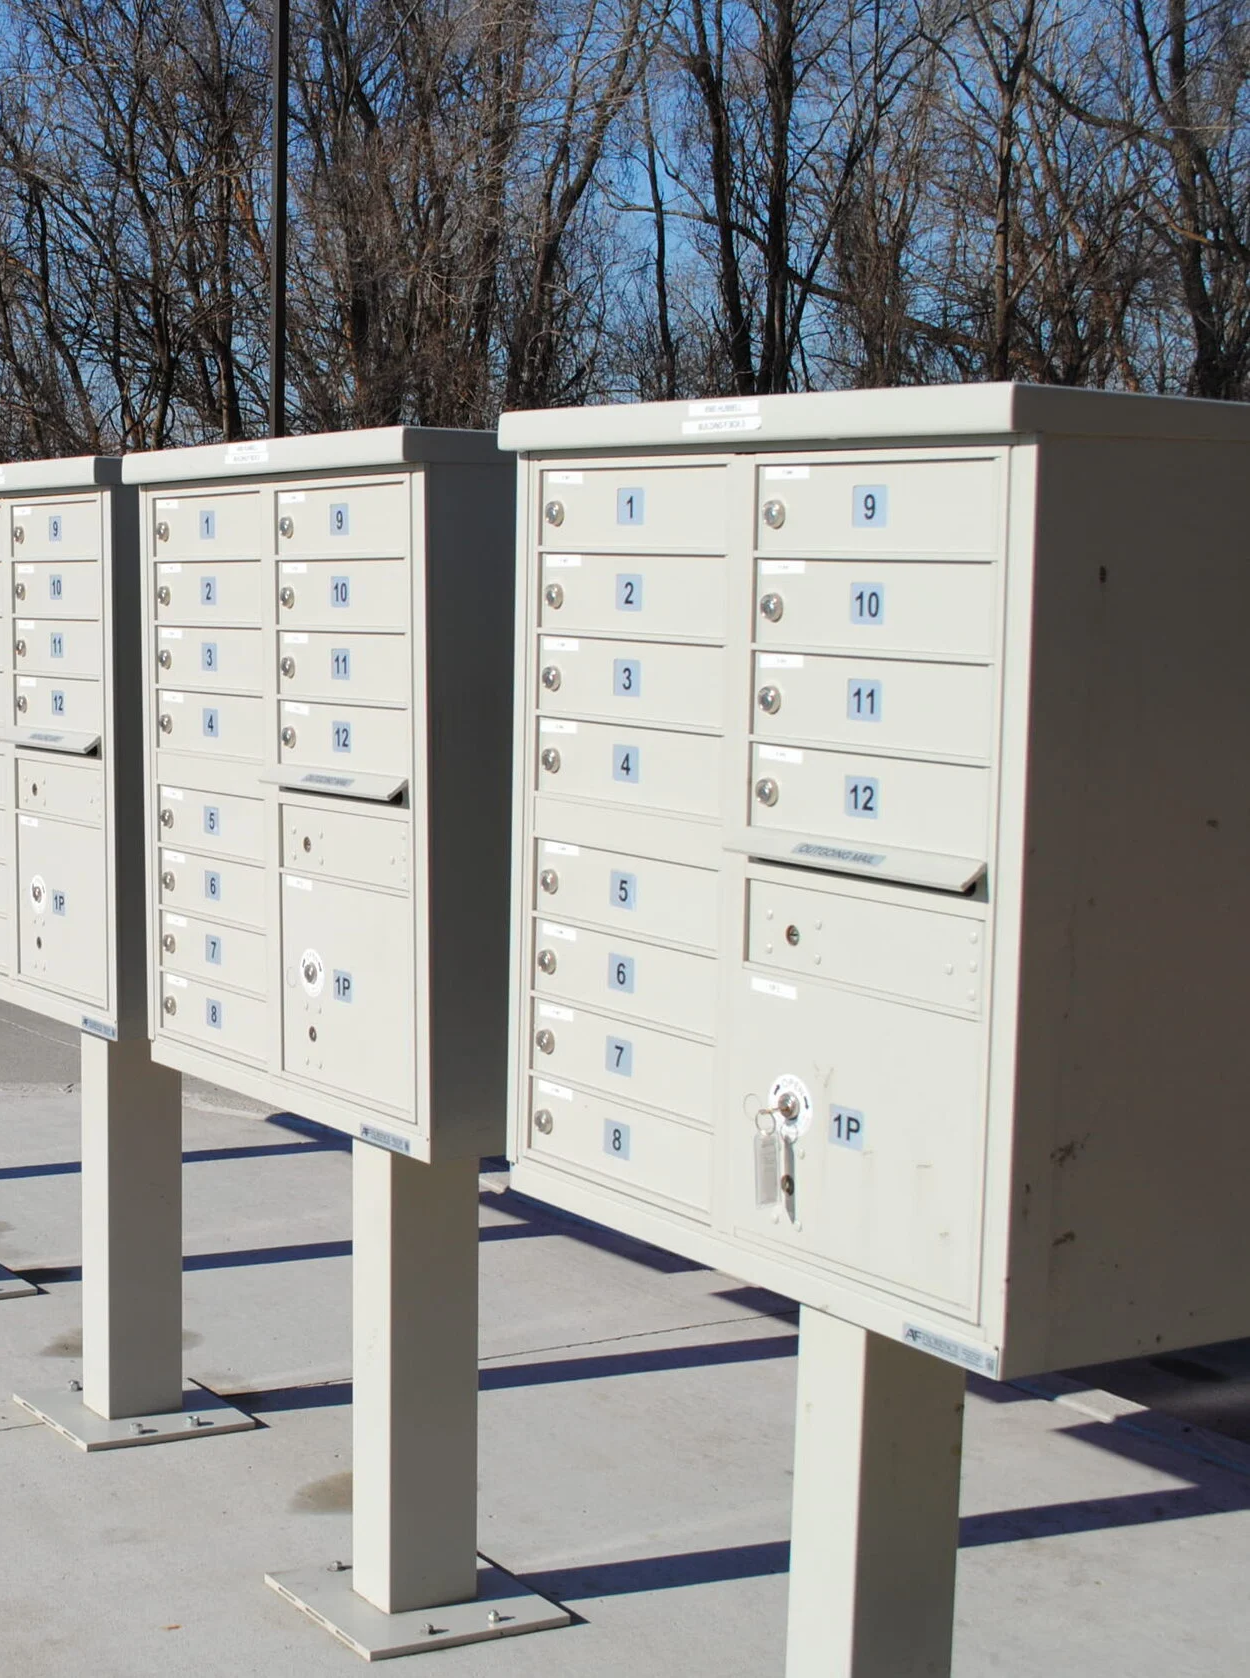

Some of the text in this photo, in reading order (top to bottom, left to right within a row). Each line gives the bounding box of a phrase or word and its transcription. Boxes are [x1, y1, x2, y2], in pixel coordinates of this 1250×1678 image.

[626, 495, 634, 519] 1
[863, 493, 877, 521] 9
[52, 521, 59, 538] 9
[204, 515, 210, 535] 1
[335, 509, 344, 531] 9
[51, 580, 62, 596] 10
[205, 581, 212, 601] 2
[333, 582, 348, 603] 10
[623, 581, 635, 605] 2
[855, 590, 880, 619] 10
[52, 638, 62, 654] 11
[206, 647, 213, 667] 3
[334, 654, 348, 675] 11
[622, 666, 633, 691] 3
[53, 696, 64, 712] 12
[852, 687, 875, 715] 11
[207, 714, 215, 733] 4
[334, 727, 350, 748] 12
[620, 752, 632, 776] 4
[849, 784, 875, 812] 12
[208, 811, 216, 831] 5
[797, 843, 875, 865] OUTGOING MAIL
[209, 876, 217, 896] 6
[618, 879, 629, 903] 5
[53, 895, 65, 911] 1P
[210, 940, 218, 959] 7
[616, 962, 627, 986] 6
[334, 975, 351, 997] 1P
[210, 1004, 218, 1024] 8
[614, 1044, 625, 1068] 7
[833, 1113, 861, 1141] 1P
[611, 1127, 622, 1152] 8
